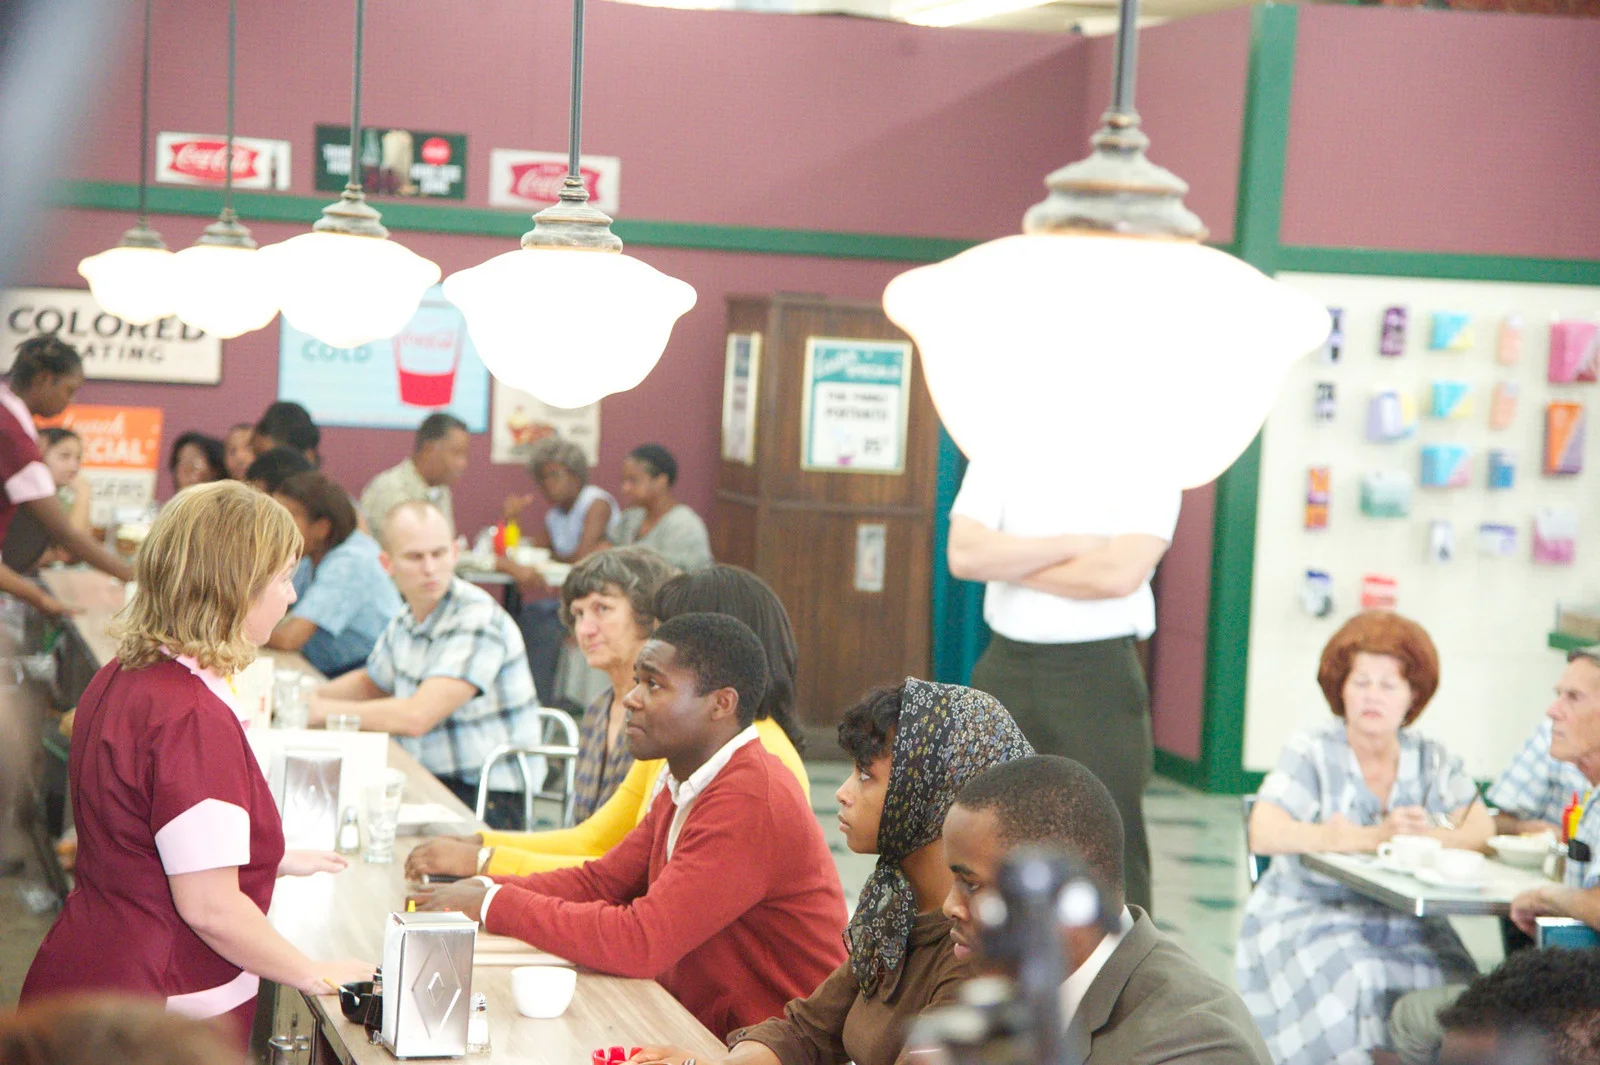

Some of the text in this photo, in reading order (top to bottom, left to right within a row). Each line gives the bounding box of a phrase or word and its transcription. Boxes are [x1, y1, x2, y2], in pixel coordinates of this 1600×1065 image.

[8, 306, 206, 340] COLORED
[83, 343, 164, 363] ATING
[301, 339, 372, 364] COLD
